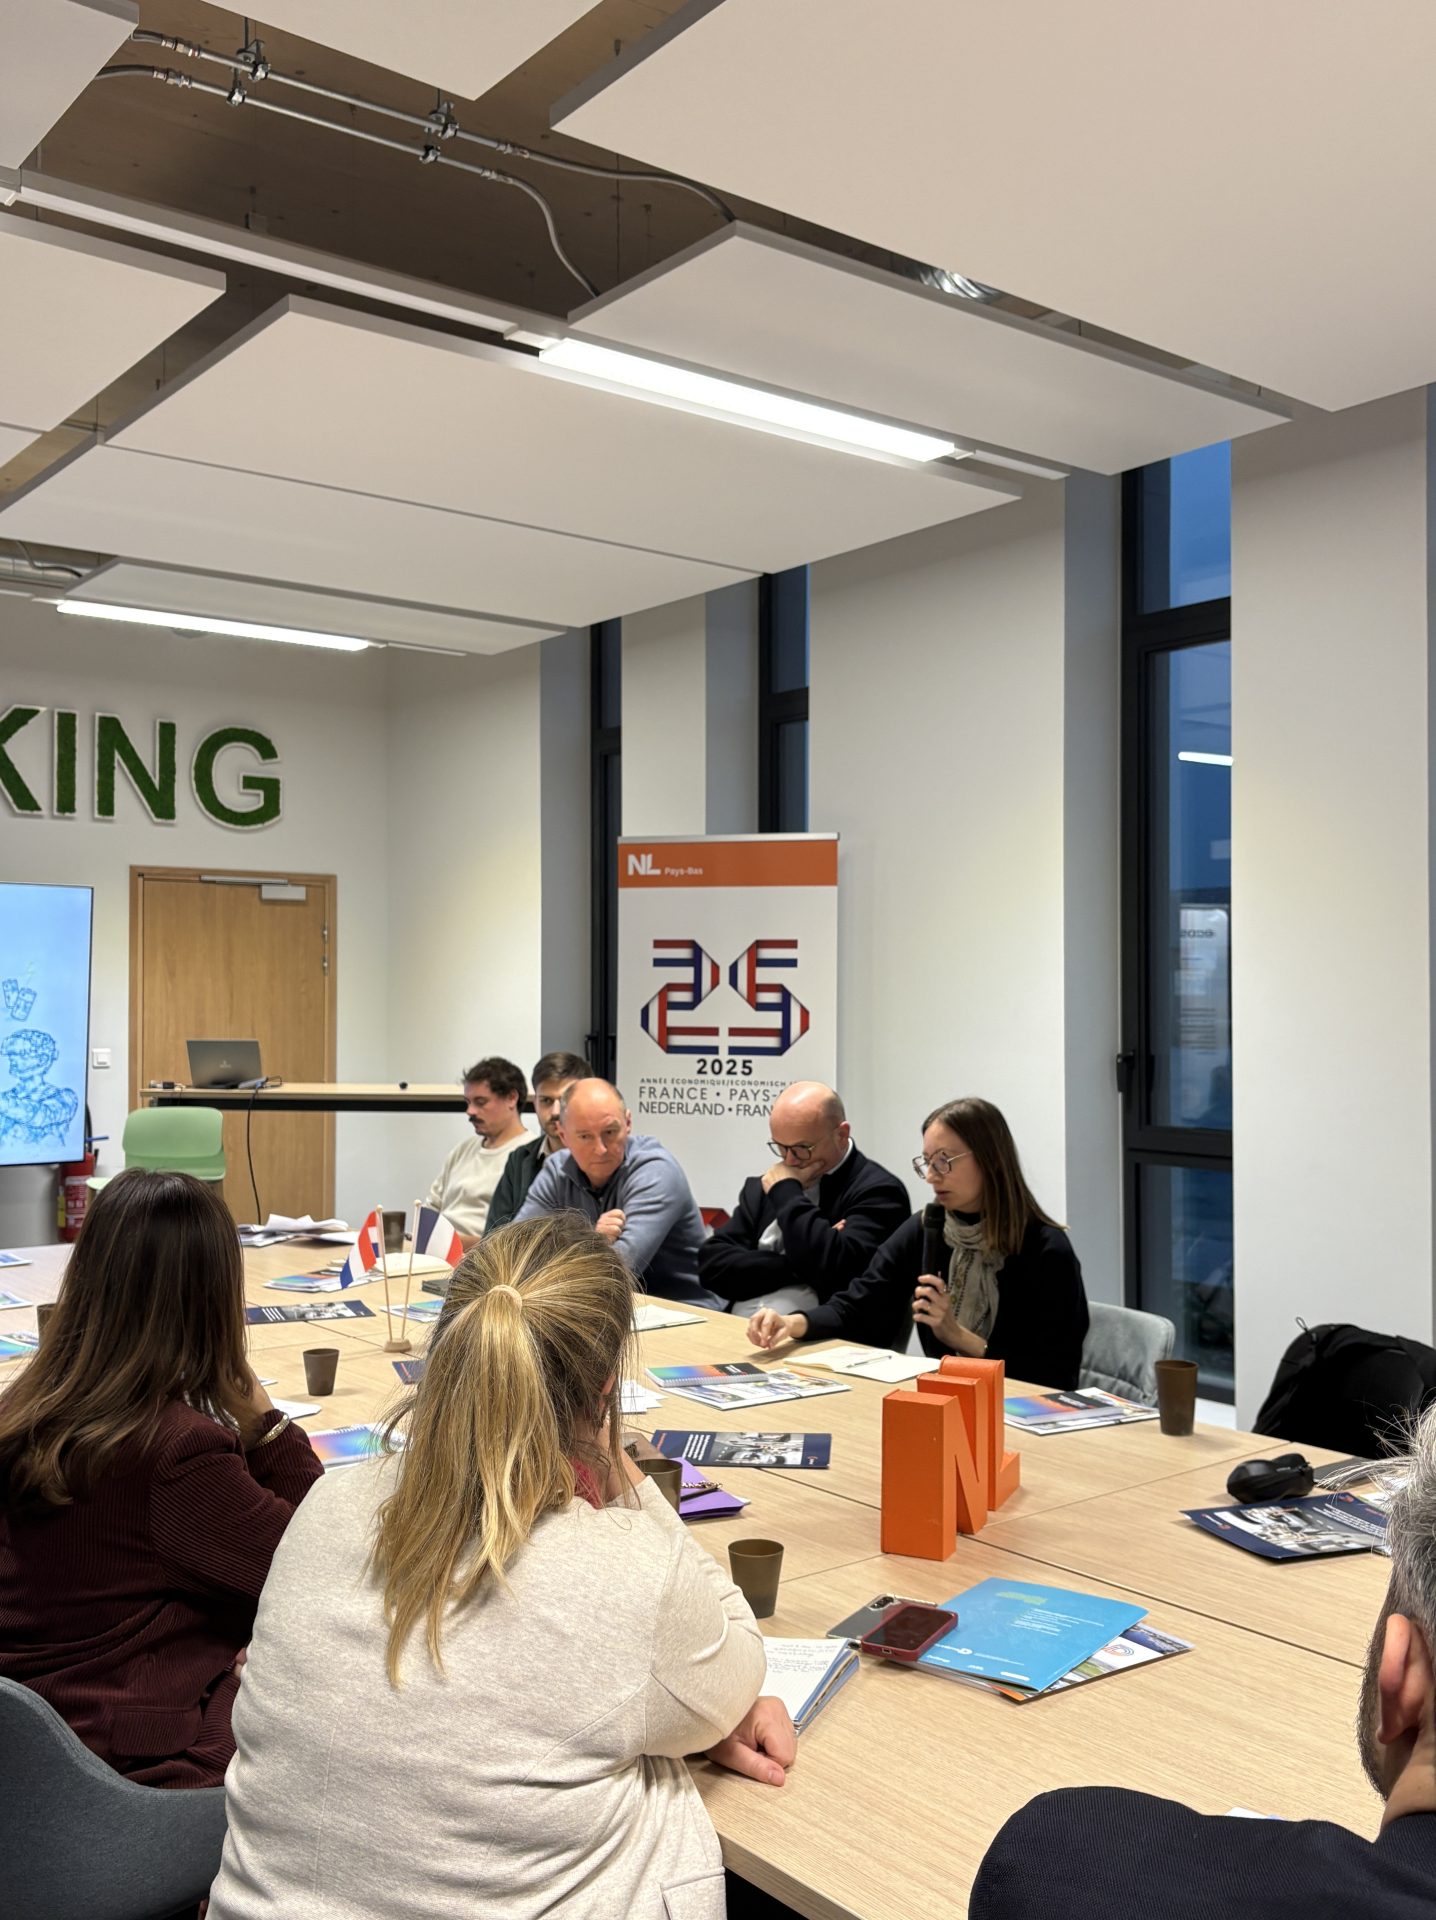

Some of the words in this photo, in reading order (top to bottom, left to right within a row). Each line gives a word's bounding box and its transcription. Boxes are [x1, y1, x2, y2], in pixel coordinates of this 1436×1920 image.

[627, 853, 661, 876] NL
[664, 866, 704, 878] Pays-Bas
[696, 1058, 753, 1076] 2025
[639, 1086, 708, 1100] FRANCE
[729, 1088, 784, 1102] PAYS-
[639, 1100, 726, 1116] NEDERLAND
[736, 1103, 774, 1117] FRAN
